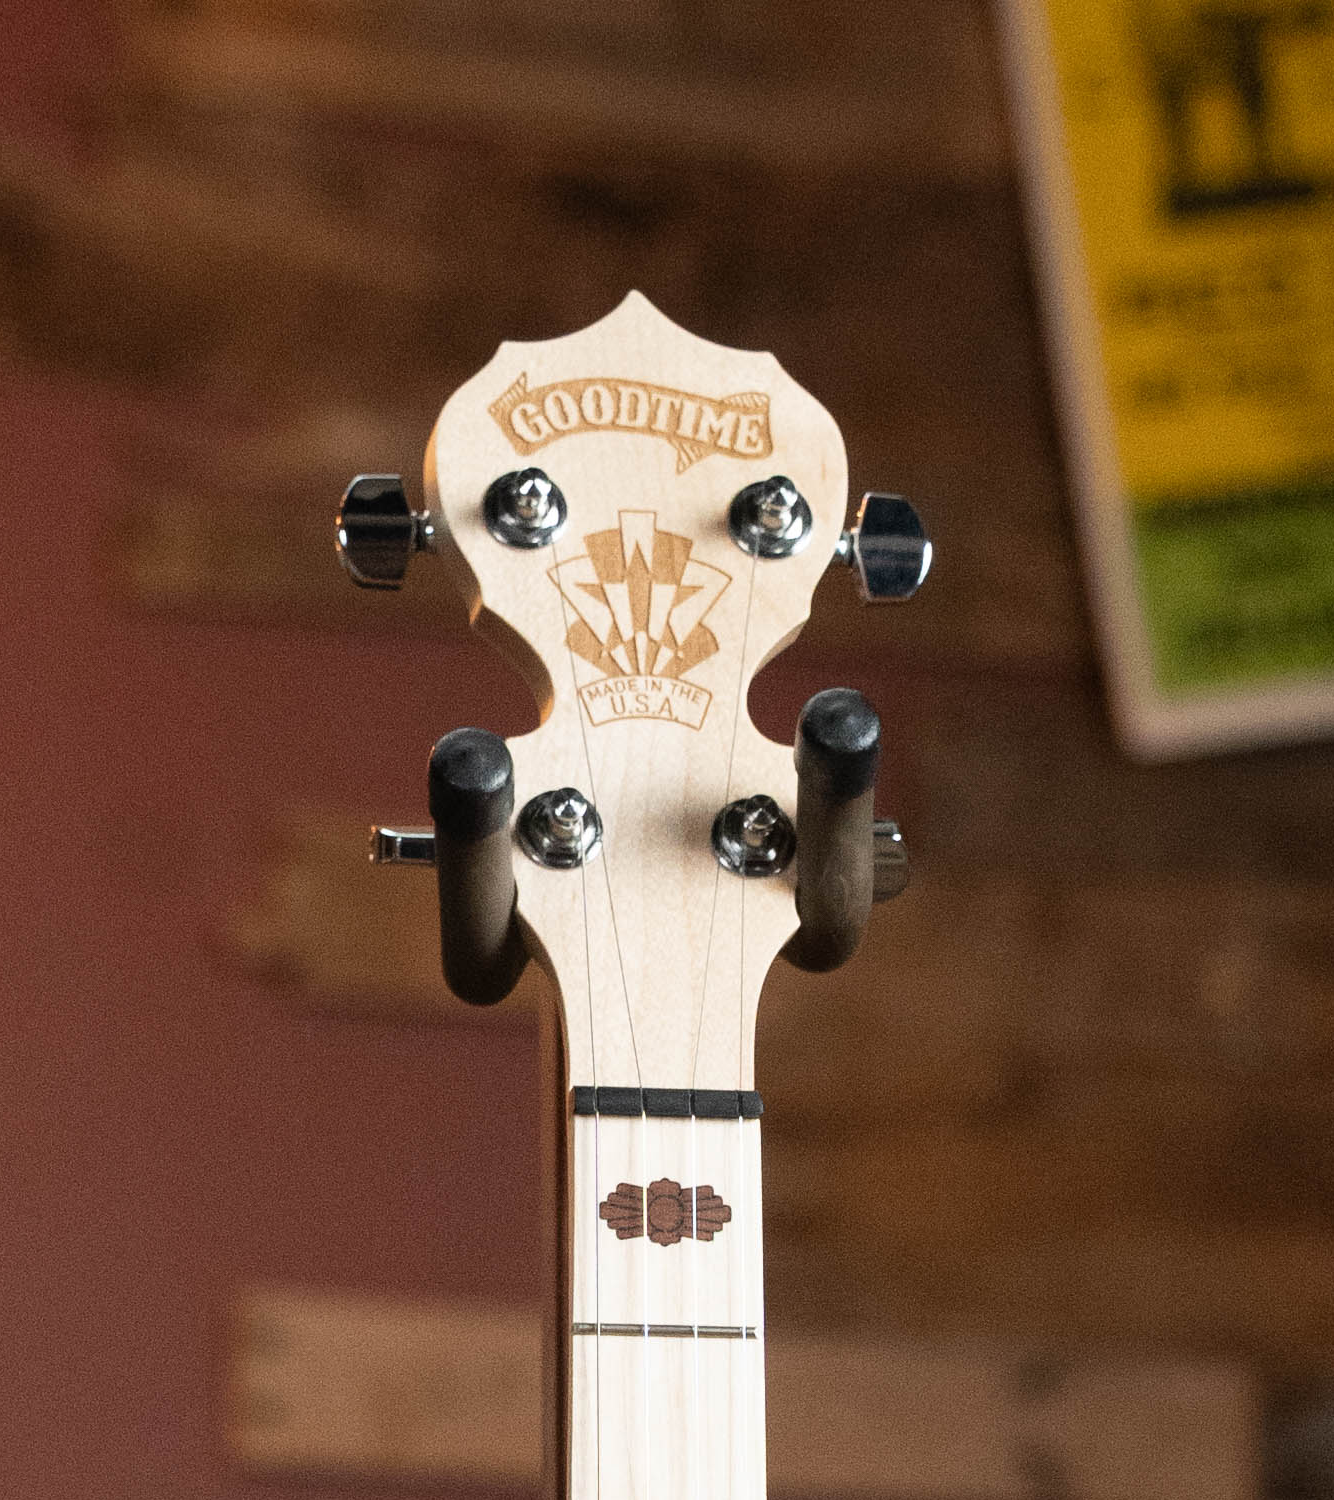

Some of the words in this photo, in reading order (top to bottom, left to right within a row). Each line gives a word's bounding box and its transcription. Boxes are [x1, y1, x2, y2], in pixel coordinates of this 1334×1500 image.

[509, 384, 766, 454] GOODTIME
[586, 679, 637, 701] MADE
[644, 679, 663, 692] IN
[670, 682, 702, 704] THE
[610, 693, 678, 720] U.S.A.
